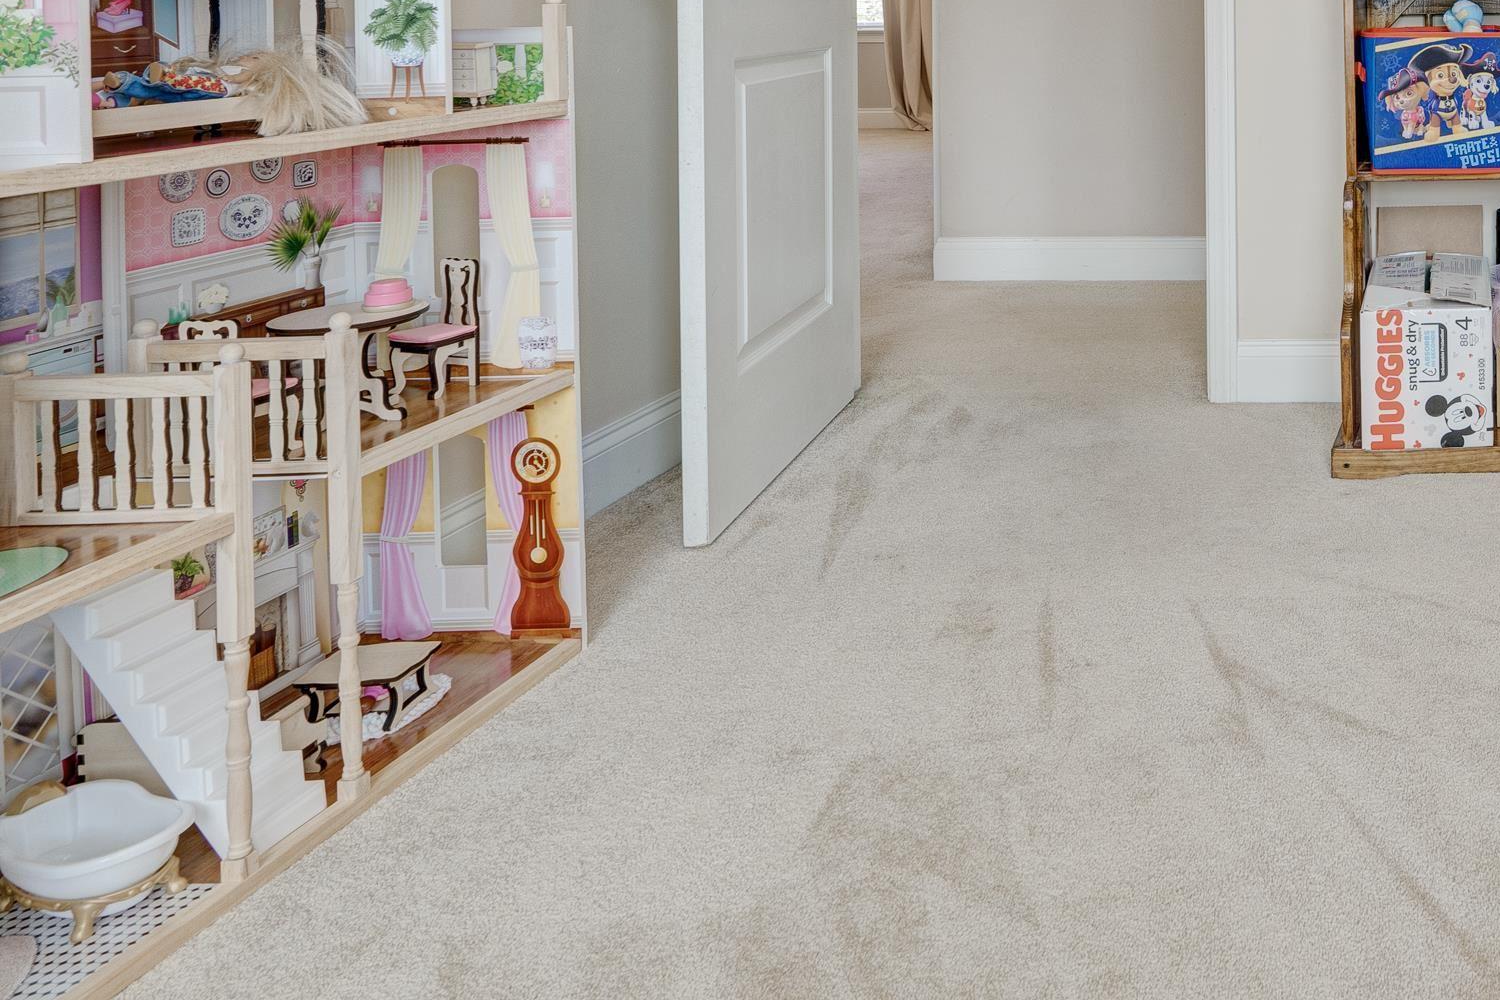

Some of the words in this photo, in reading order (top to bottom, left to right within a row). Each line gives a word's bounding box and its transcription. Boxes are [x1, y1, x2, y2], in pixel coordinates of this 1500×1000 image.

[1460, 148, 1500, 169] PUPS!
[1405, 320, 1420, 343] dry
[1455, 316, 1473, 331] 4
[1459, 333, 1469, 347] 88
[1406, 345, 1417, 356] &
[1408, 358, 1421, 392] snug
